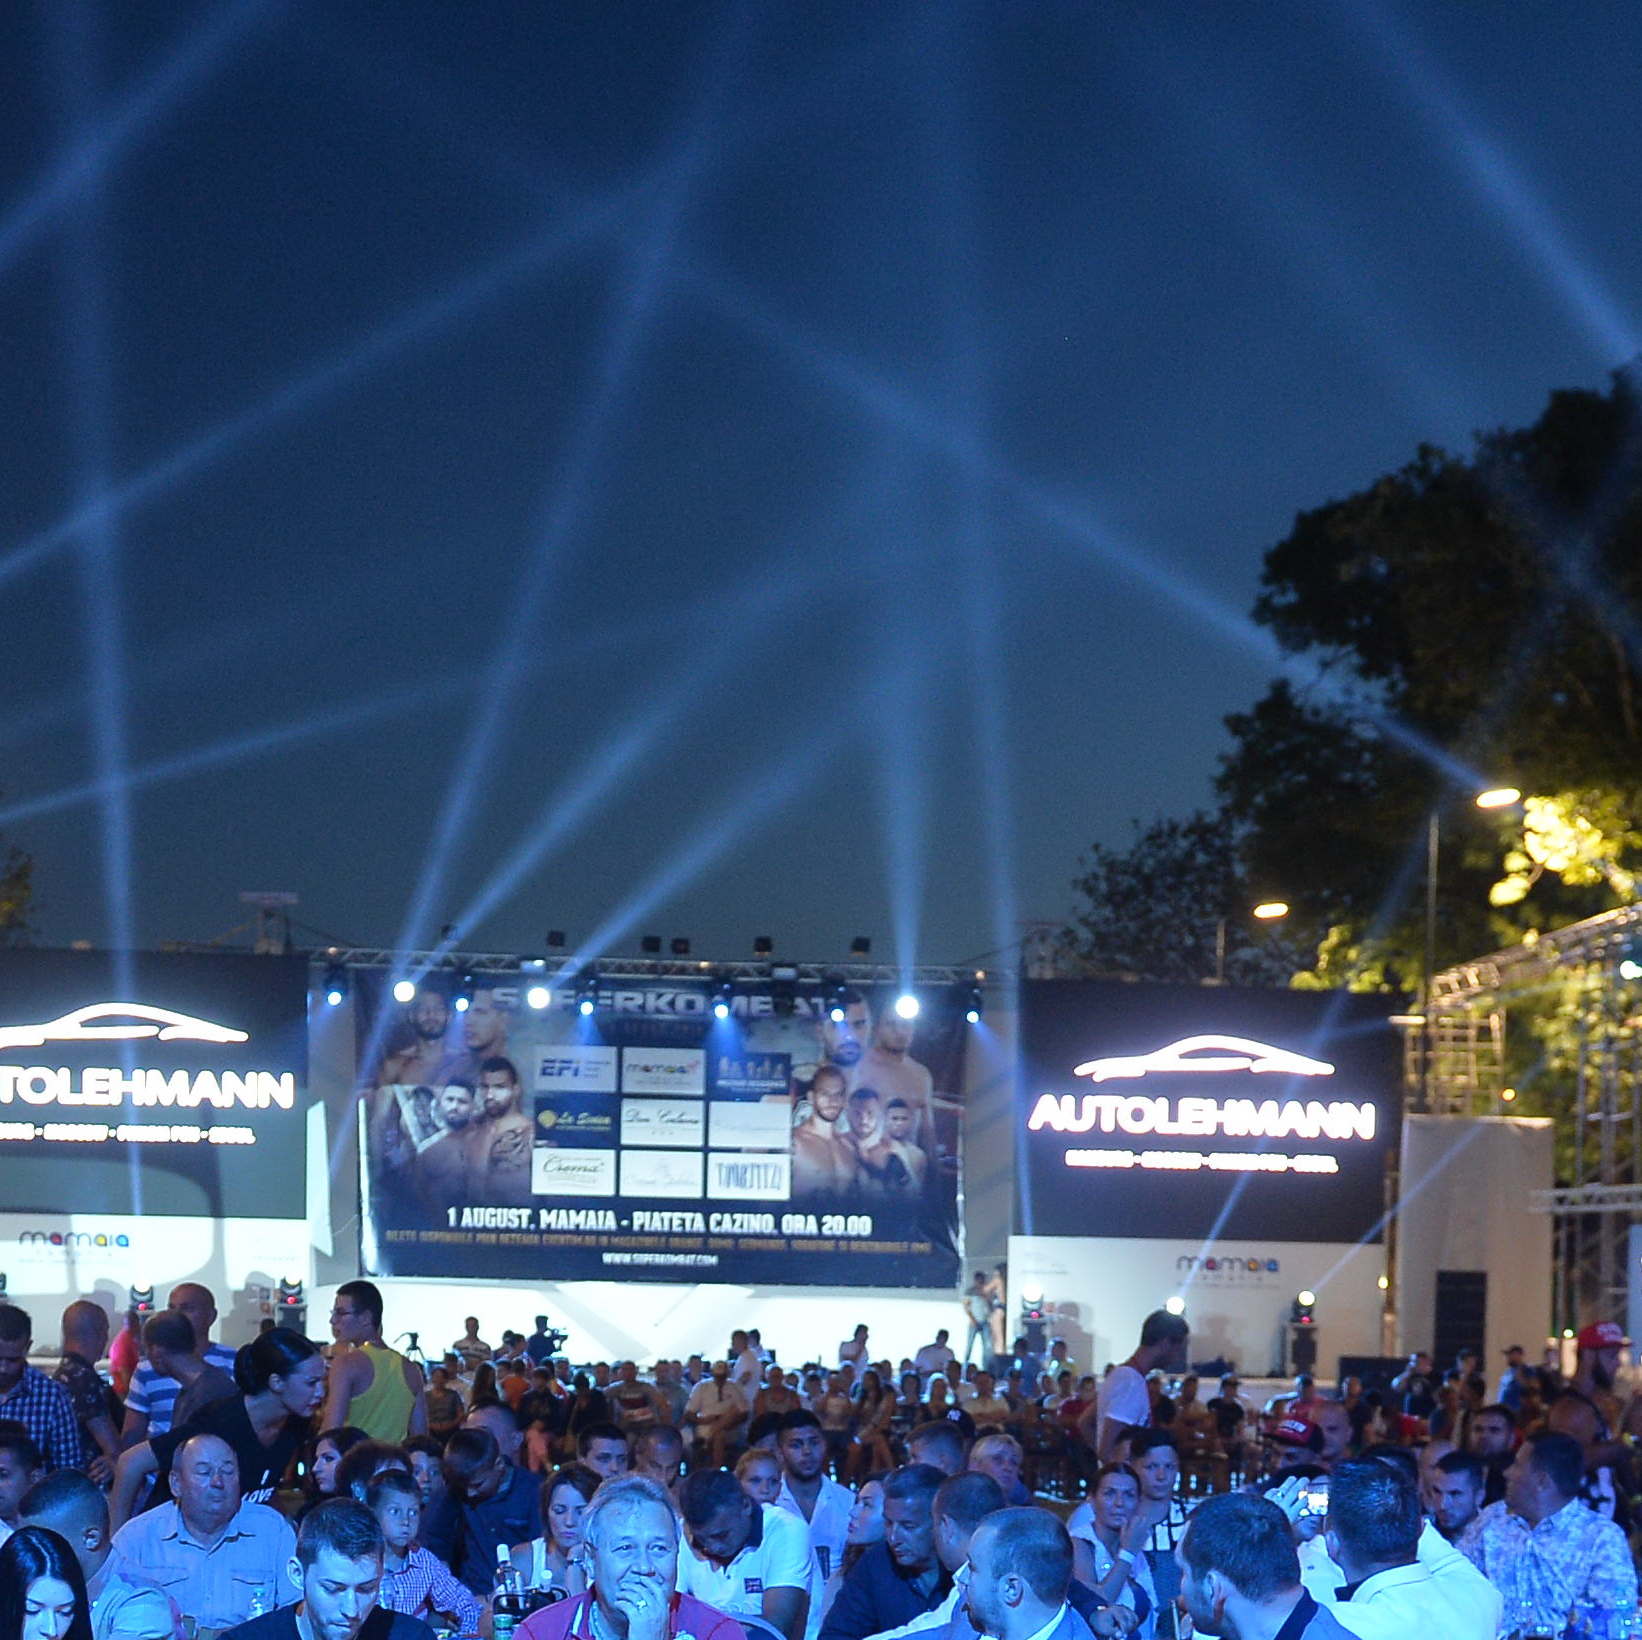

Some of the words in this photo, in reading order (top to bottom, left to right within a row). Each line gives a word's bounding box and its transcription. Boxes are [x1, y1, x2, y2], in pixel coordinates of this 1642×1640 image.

[1028, 1094, 1375, 1140] AUTOLEHMANN
[447, 1207, 456, 1226] 1
[539, 1208, 617, 1231] MAMAIA
[632, 1211, 705, 1233] PIATETA
[781, 1214, 818, 1235] ORA
[821, 1215, 873, 1237] 20.00
[19, 1231, 129, 1247] mamaia
